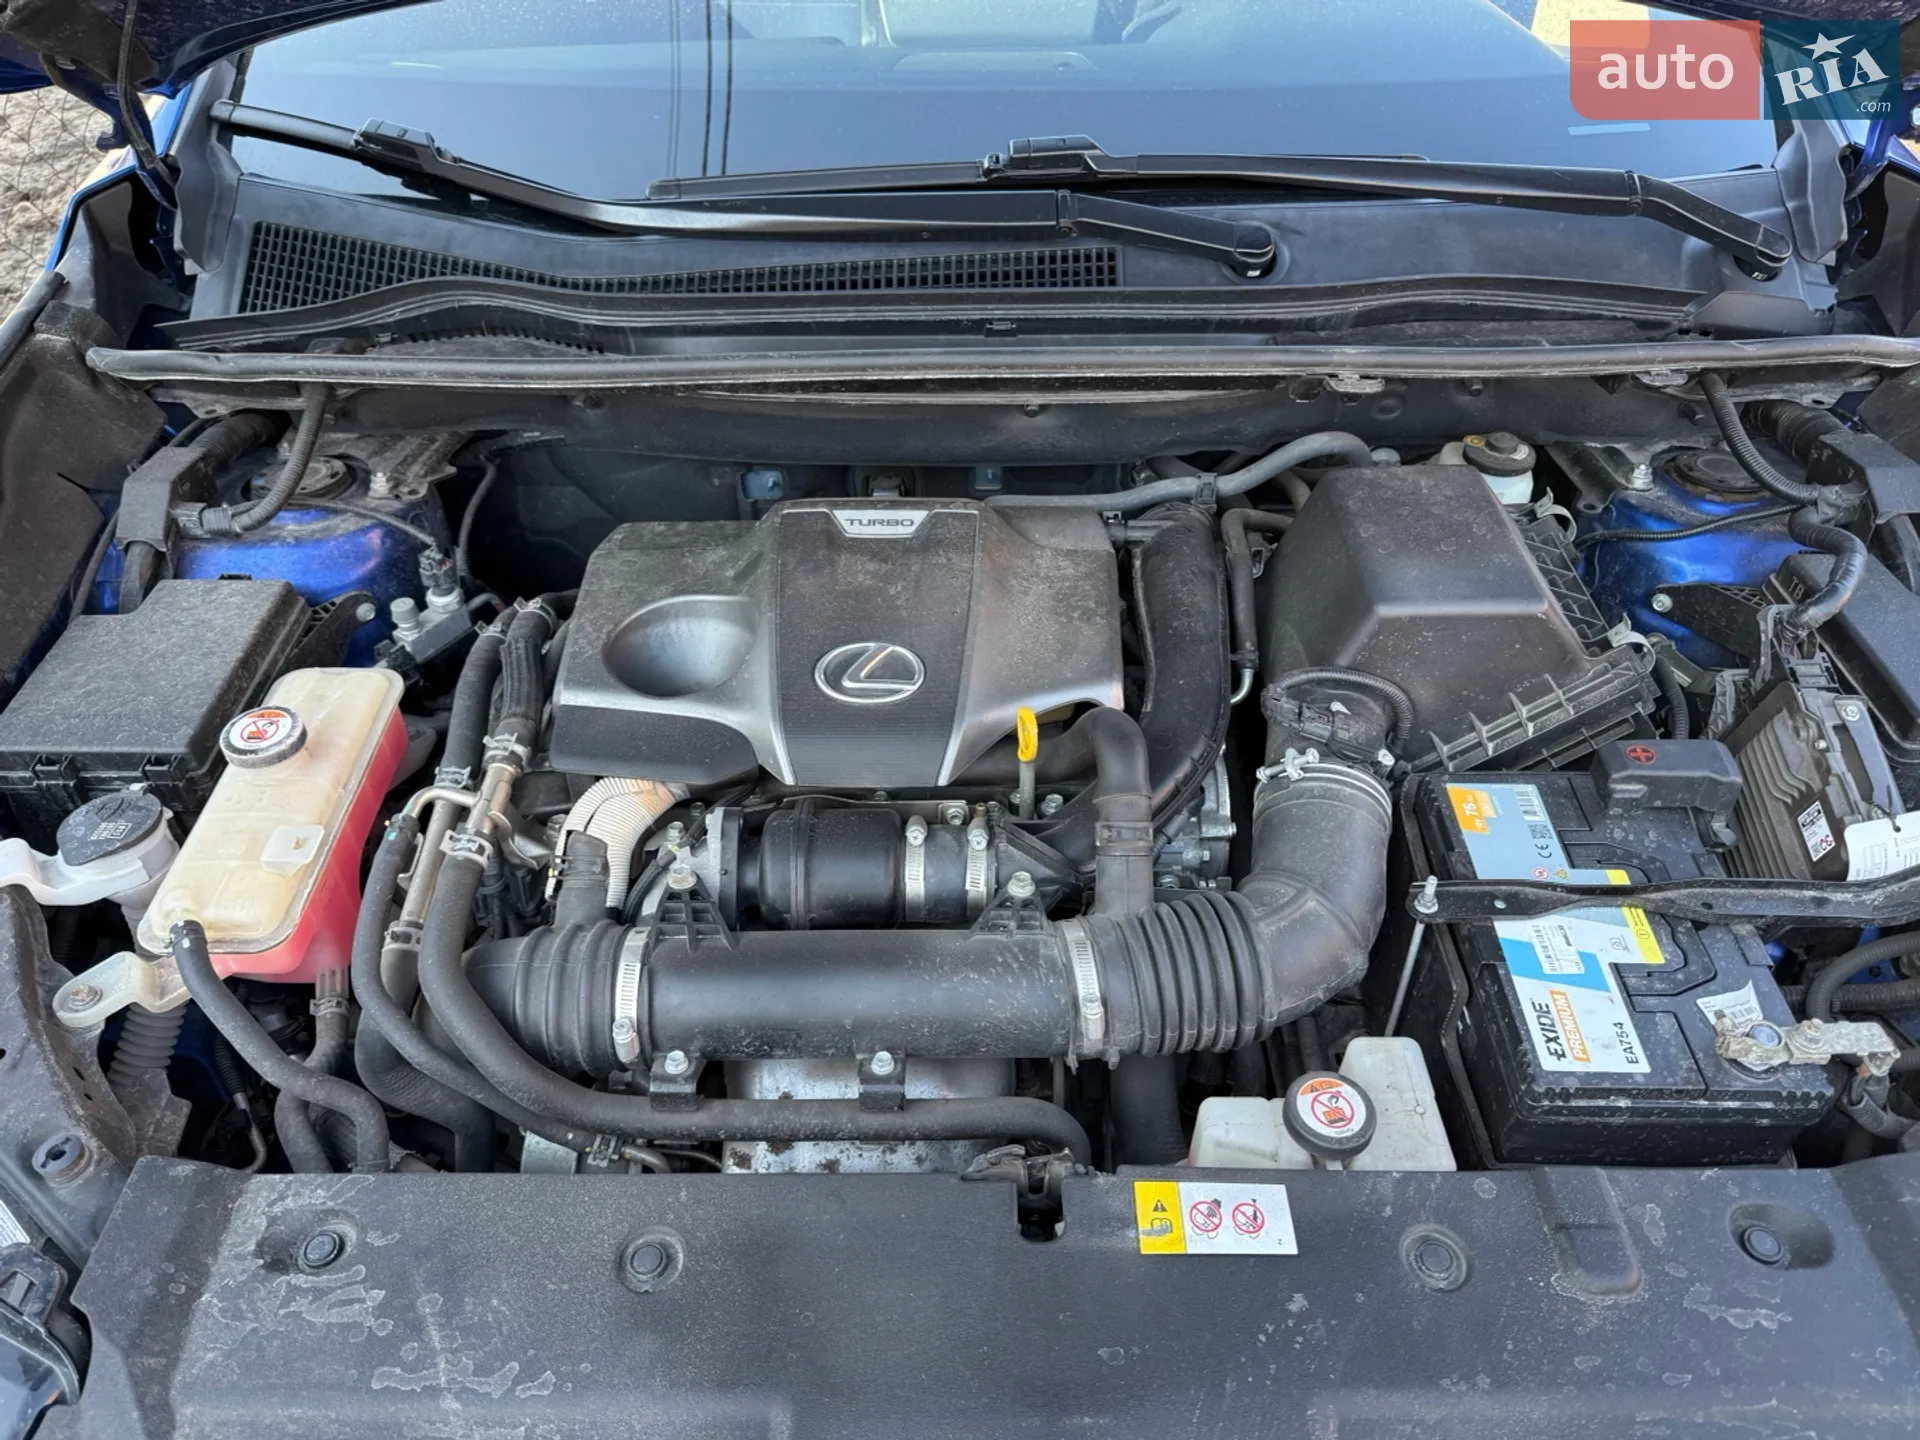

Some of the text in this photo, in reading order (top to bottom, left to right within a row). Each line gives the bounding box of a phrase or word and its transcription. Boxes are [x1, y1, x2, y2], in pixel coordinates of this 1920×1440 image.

[844, 518, 915, 527] TURBO
[1531, 998, 1567, 1061] EXIDE
[1552, 992, 1588, 1060] PREMIUM
[1612, 1021, 1640, 1064] EA754
